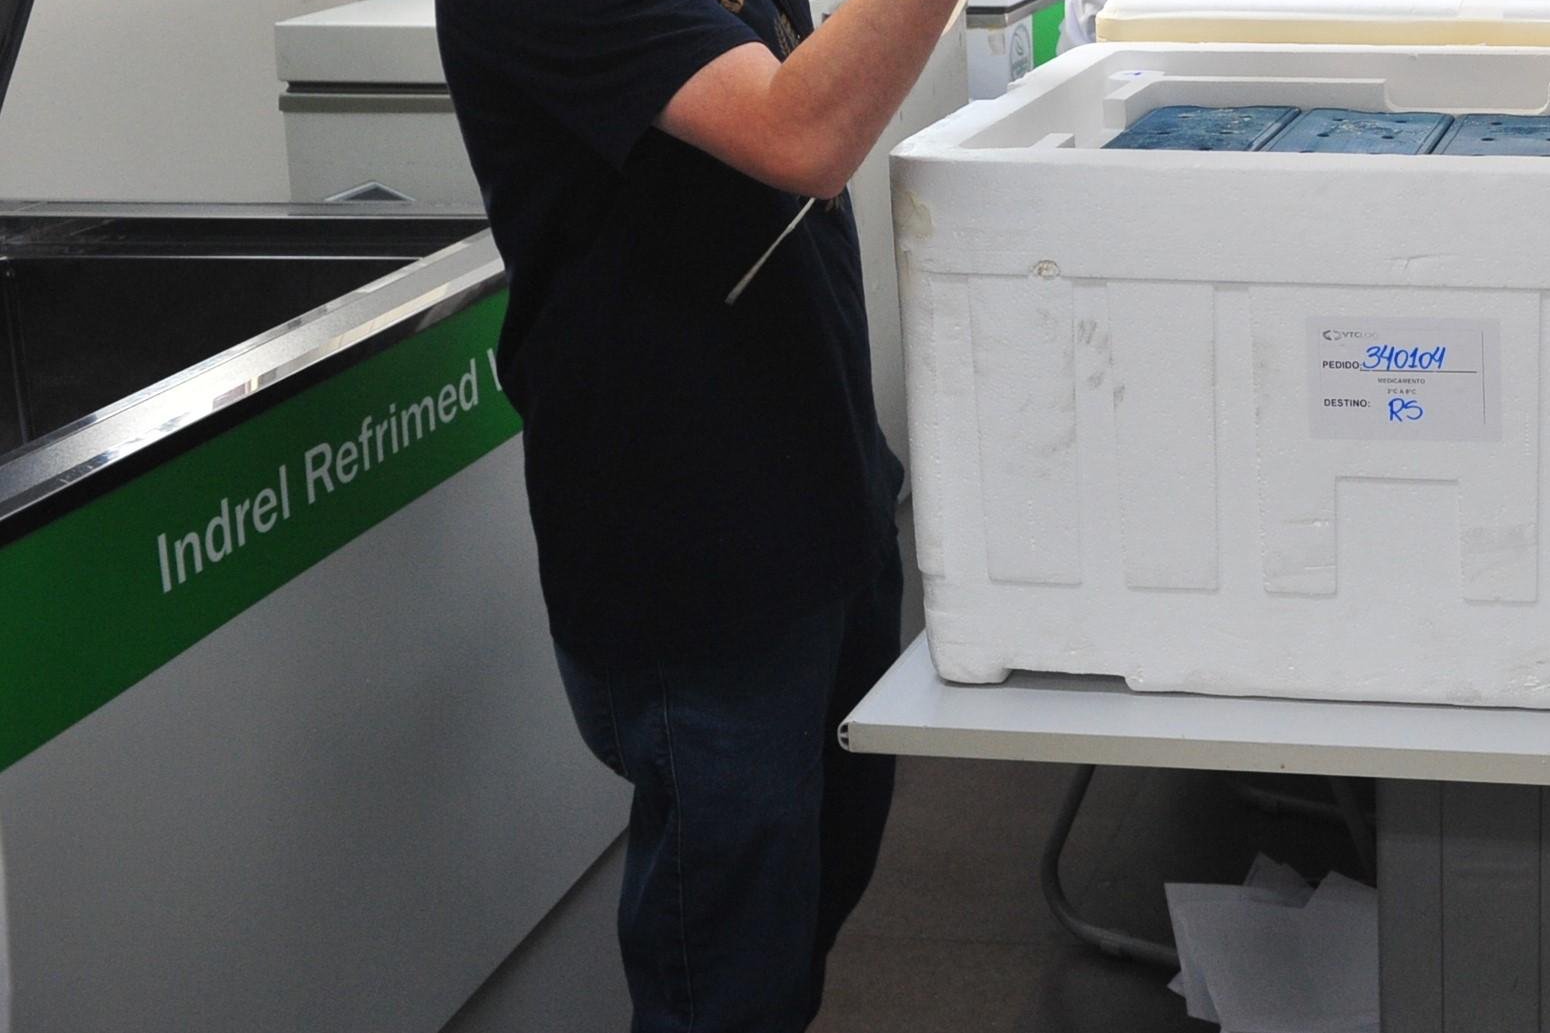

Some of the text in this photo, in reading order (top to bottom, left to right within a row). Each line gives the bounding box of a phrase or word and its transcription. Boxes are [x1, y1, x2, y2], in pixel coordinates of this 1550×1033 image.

[1362, 344, 1446, 372] 340104
[1323, 397, 1424, 422] DESTINO: RS
[156, 359, 480, 594] Indrel Refrimed
